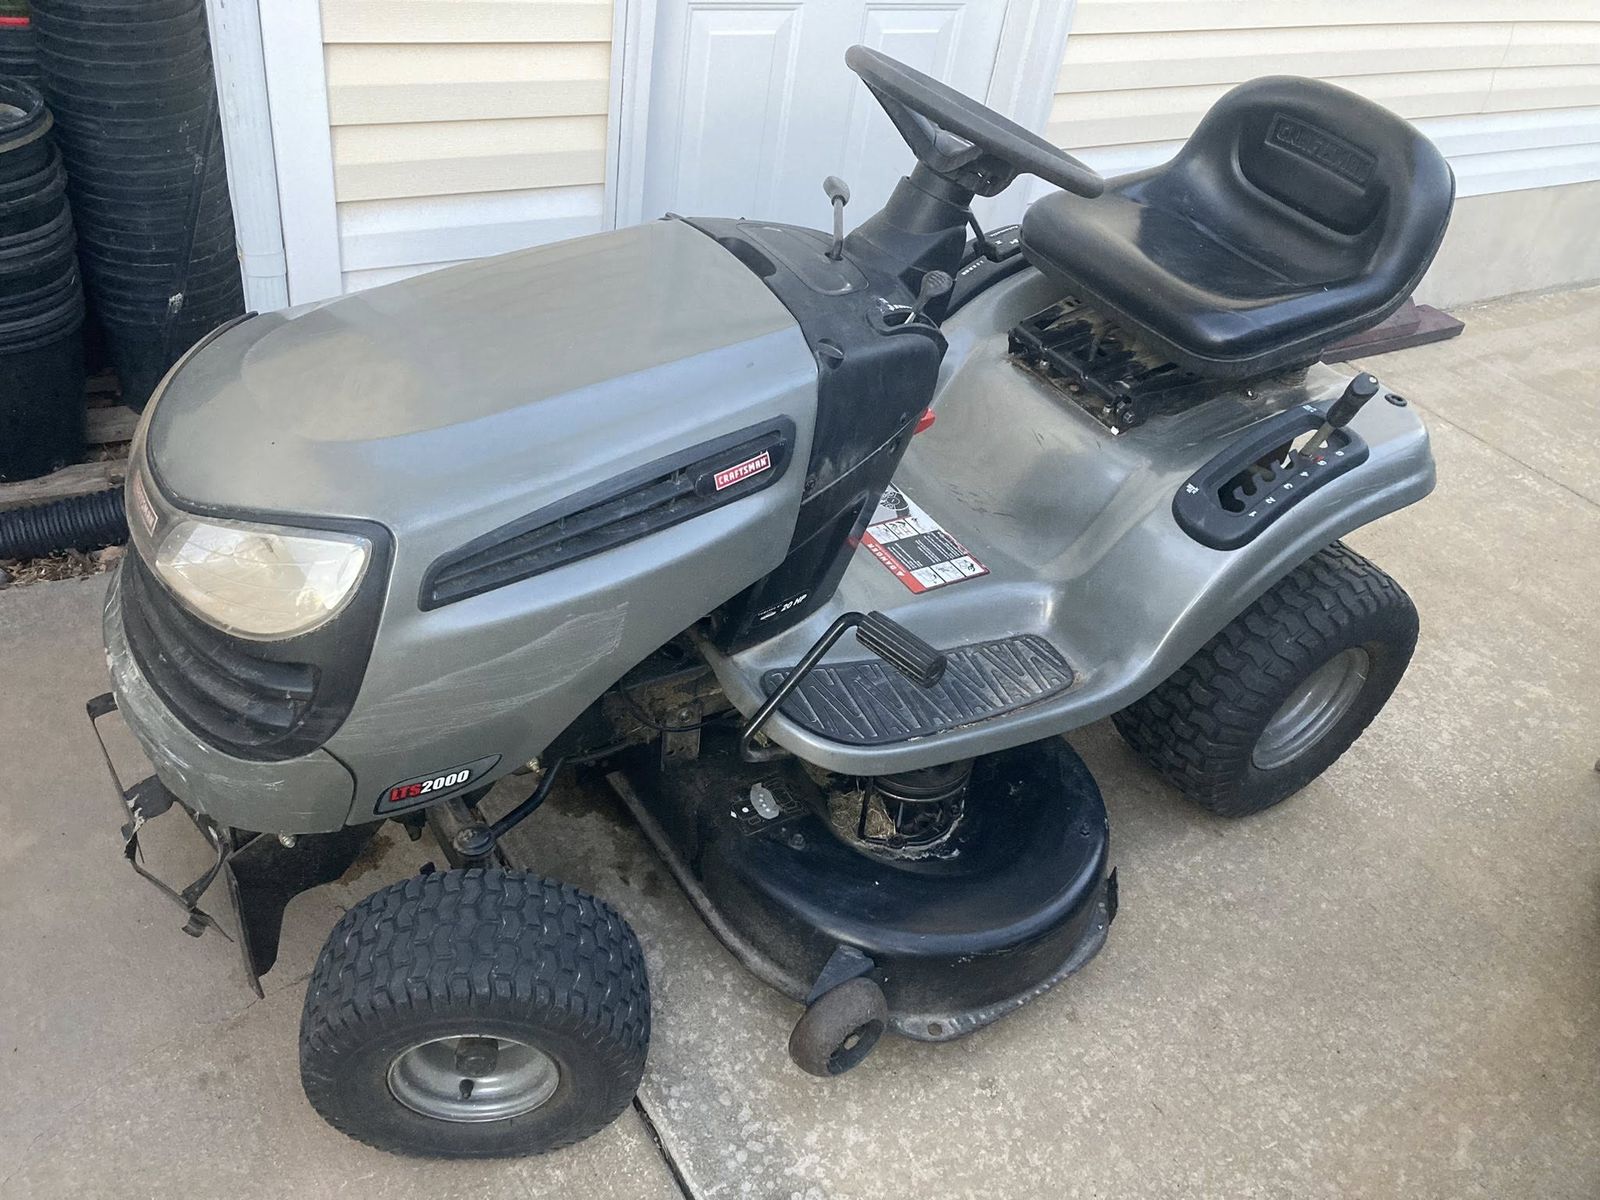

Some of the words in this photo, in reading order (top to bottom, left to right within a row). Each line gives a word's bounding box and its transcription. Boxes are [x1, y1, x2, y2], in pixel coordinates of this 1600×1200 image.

[717, 456, 768, 486] CRAFTSMAN
[1283, 482, 1294, 490] 3
[1265, 496, 1276, 504] 2
[866, 542, 898, 571] DANGER
[781, 601, 793, 612] 20
[390, 769, 470, 802] LTS2000
